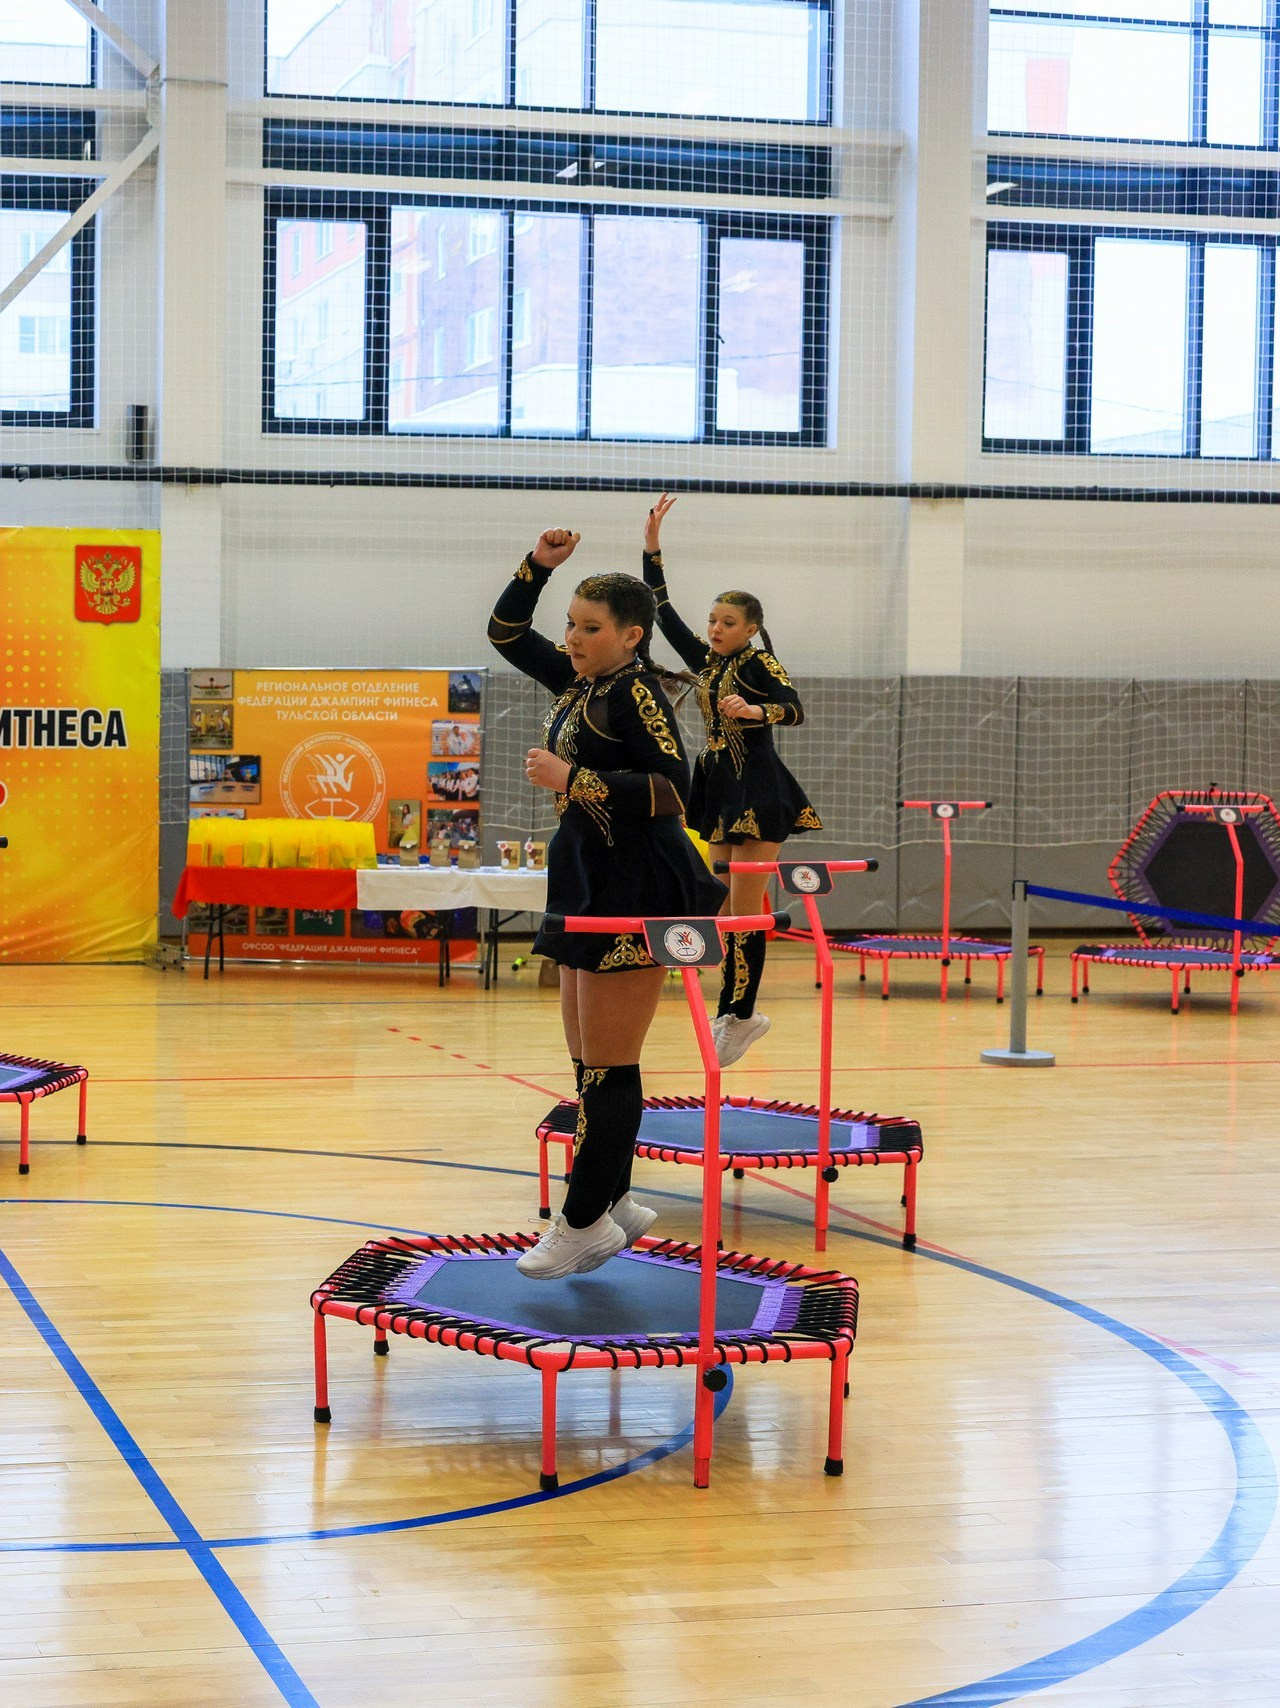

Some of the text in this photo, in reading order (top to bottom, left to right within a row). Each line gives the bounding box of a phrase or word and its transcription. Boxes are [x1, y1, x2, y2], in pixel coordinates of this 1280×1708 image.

[256, 681, 419, 693] РЕГИОНАЛЬНОЕ ОТДЕЛЕНИЕ
[237, 696, 438, 708] ФЕДЕРАЦИИ ДЖАМПИНГ ФИТНЕСА
[276, 709, 398, 721] ТУЛЬСКОЙ ОБЛАСТИ
[329, 946, 377, 954] ДЖАМПИНГ
